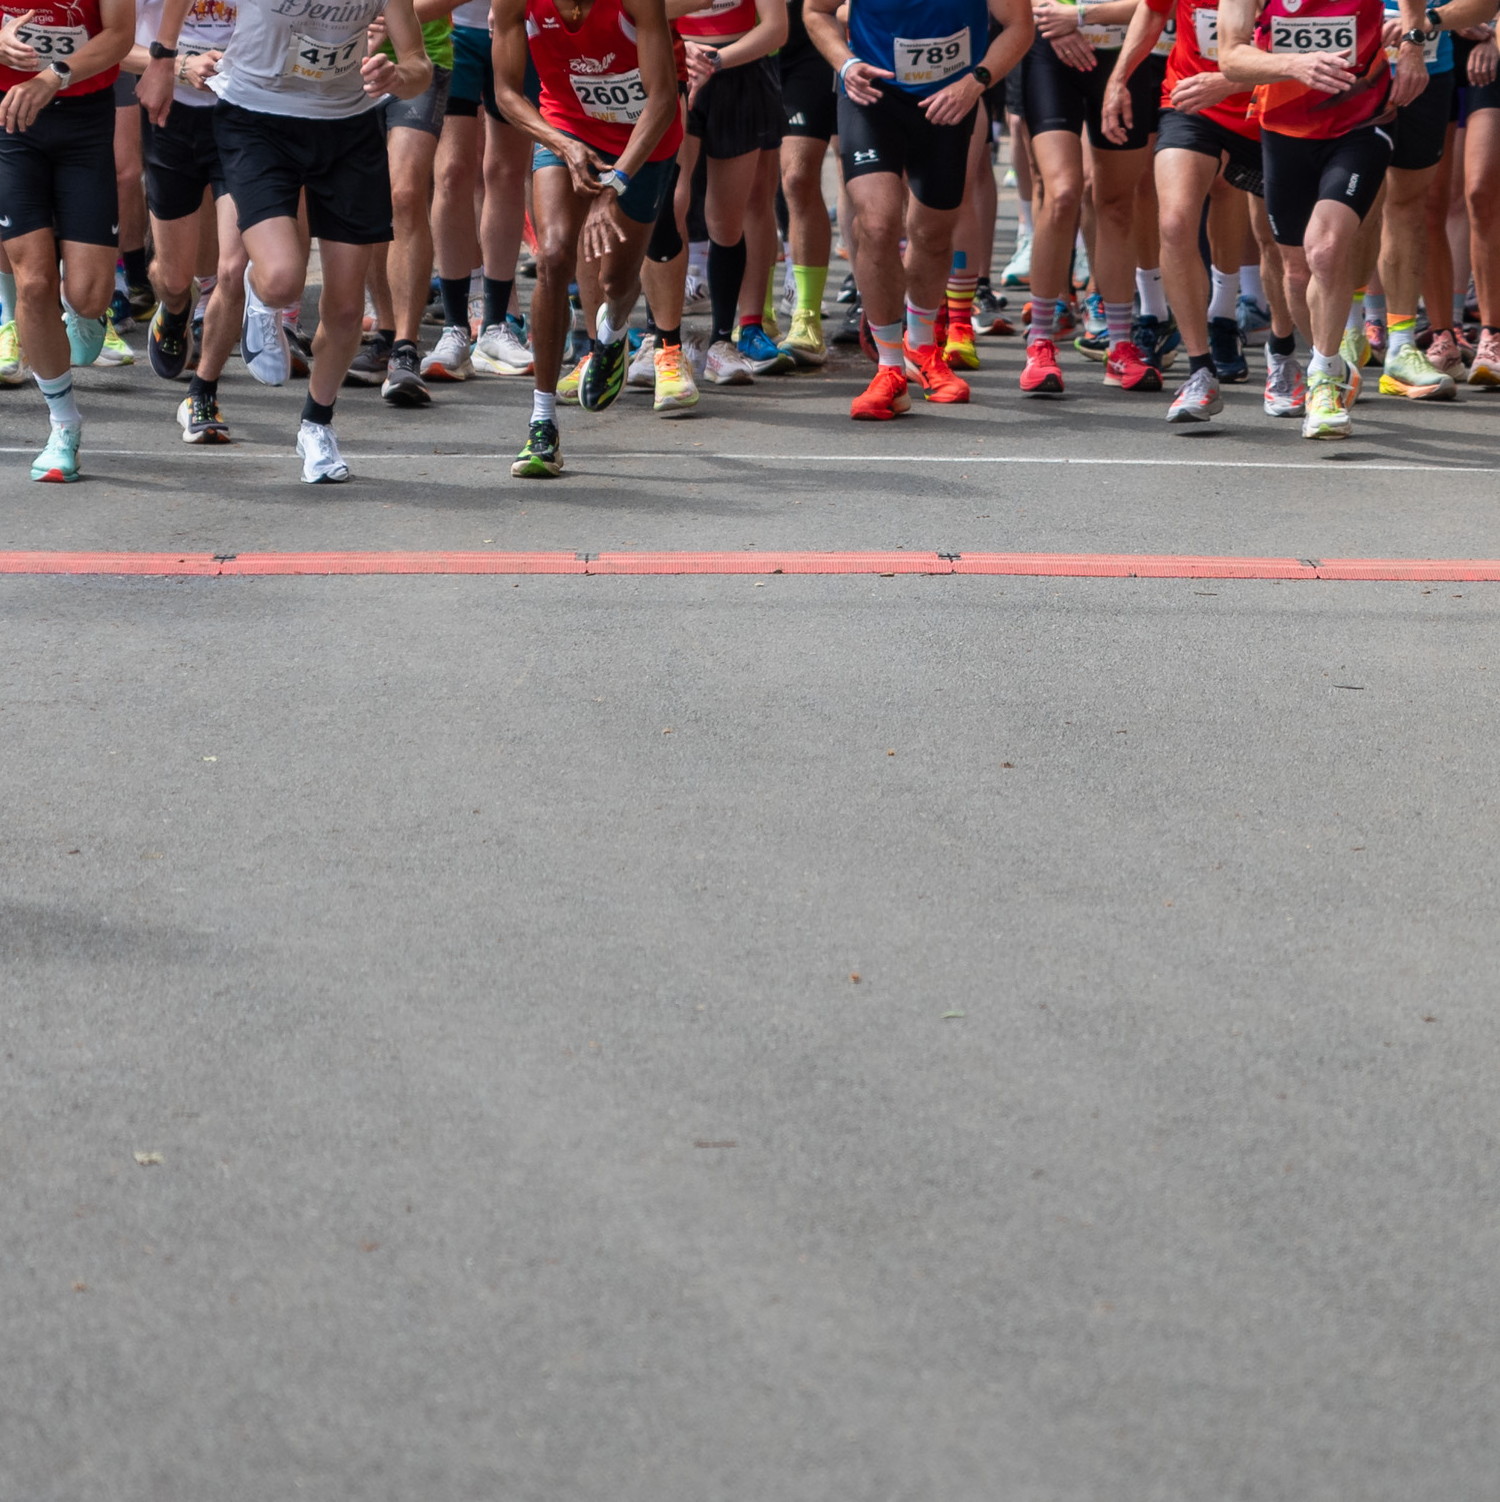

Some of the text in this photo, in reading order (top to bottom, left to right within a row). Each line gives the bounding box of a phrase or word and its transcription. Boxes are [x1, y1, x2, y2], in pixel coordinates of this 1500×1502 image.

[1274, 27, 1353, 49] 2636
[300, 40, 358, 66] 417
[906, 42, 960, 66] 789
[292, 64, 324, 79] EWE
[903, 70, 933, 81] EWE
[943, 61, 966, 75] bruns
[575, 81, 648, 106] 2603
[626, 111, 643, 119] bru
